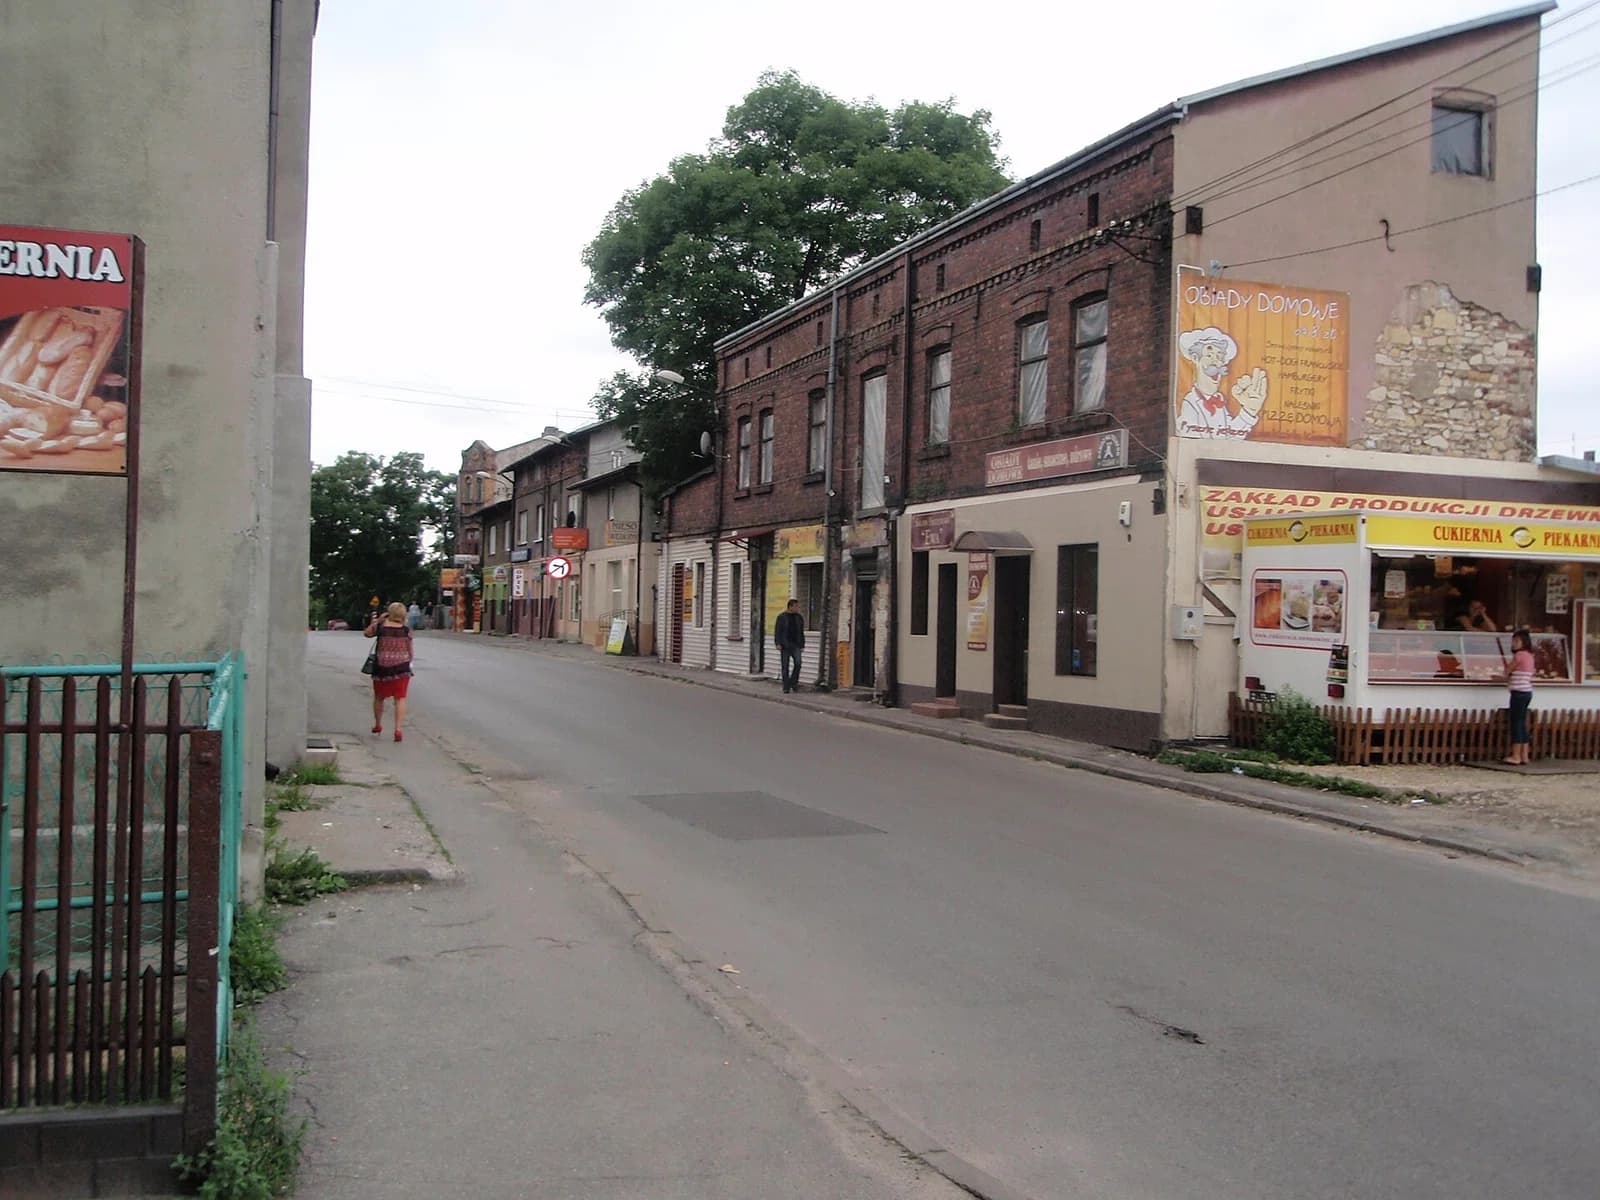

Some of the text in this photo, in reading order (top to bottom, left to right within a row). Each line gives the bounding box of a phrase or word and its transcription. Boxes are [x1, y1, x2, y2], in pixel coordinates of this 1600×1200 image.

[0, 240, 124, 283] ERNIA
[1184, 286, 1340, 321] OBIADY DOMOWE
[1205, 490, 1321, 507] ZAKŁAD
[1331, 497, 1490, 516] PRODUKCJI
[1309, 523, 1355, 538] PIEKARNIA
[1433, 525, 1503, 543] CUKIERNIA
